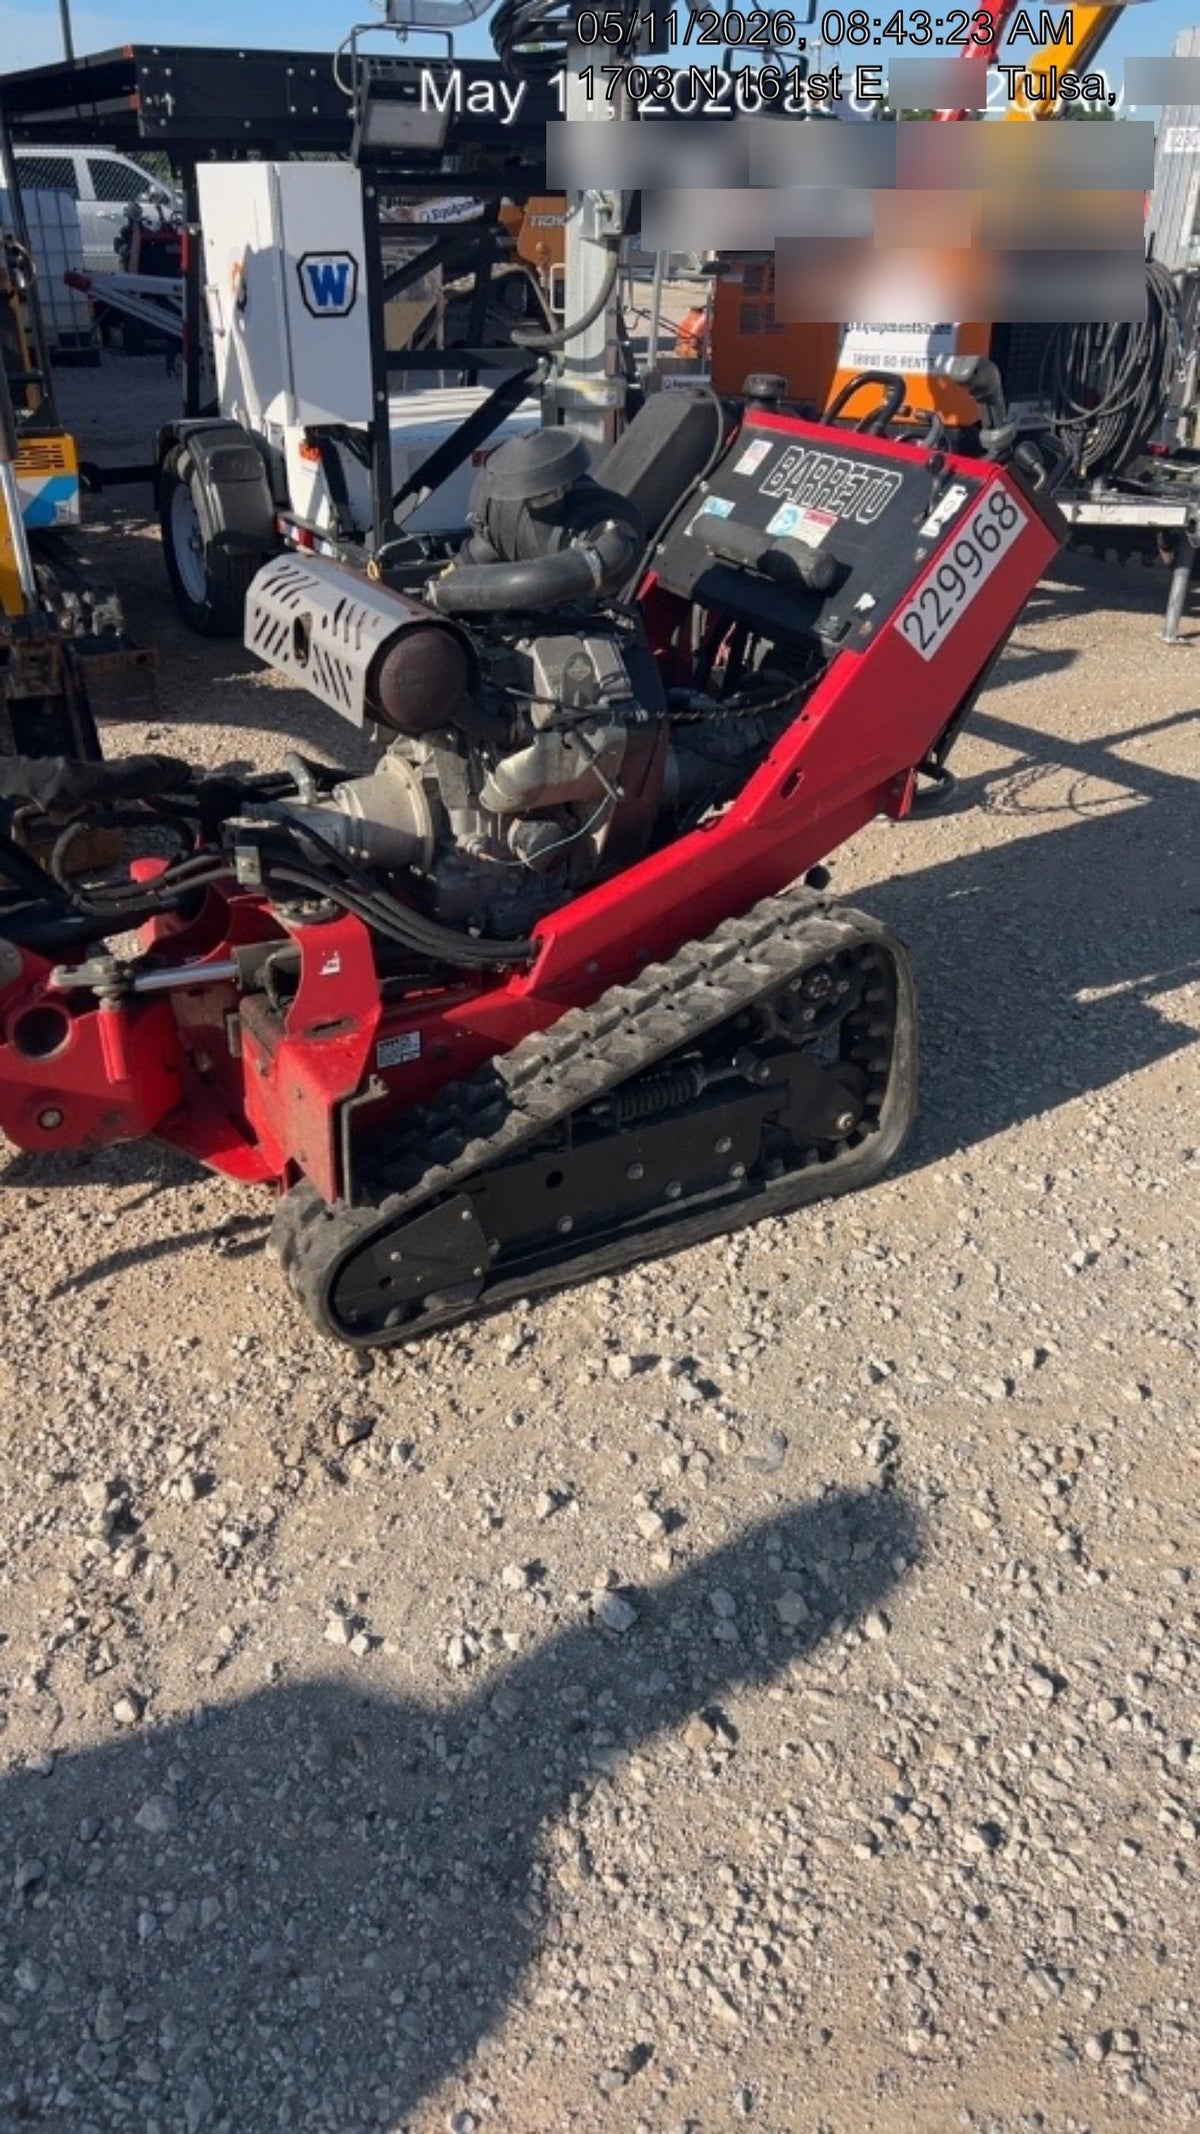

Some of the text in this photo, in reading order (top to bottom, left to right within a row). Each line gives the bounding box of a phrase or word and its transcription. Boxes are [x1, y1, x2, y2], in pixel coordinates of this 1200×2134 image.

[306, 264, 349, 307] W
[759, 445, 904, 524] BARRETO
[903, 490, 1018, 651] 229968
